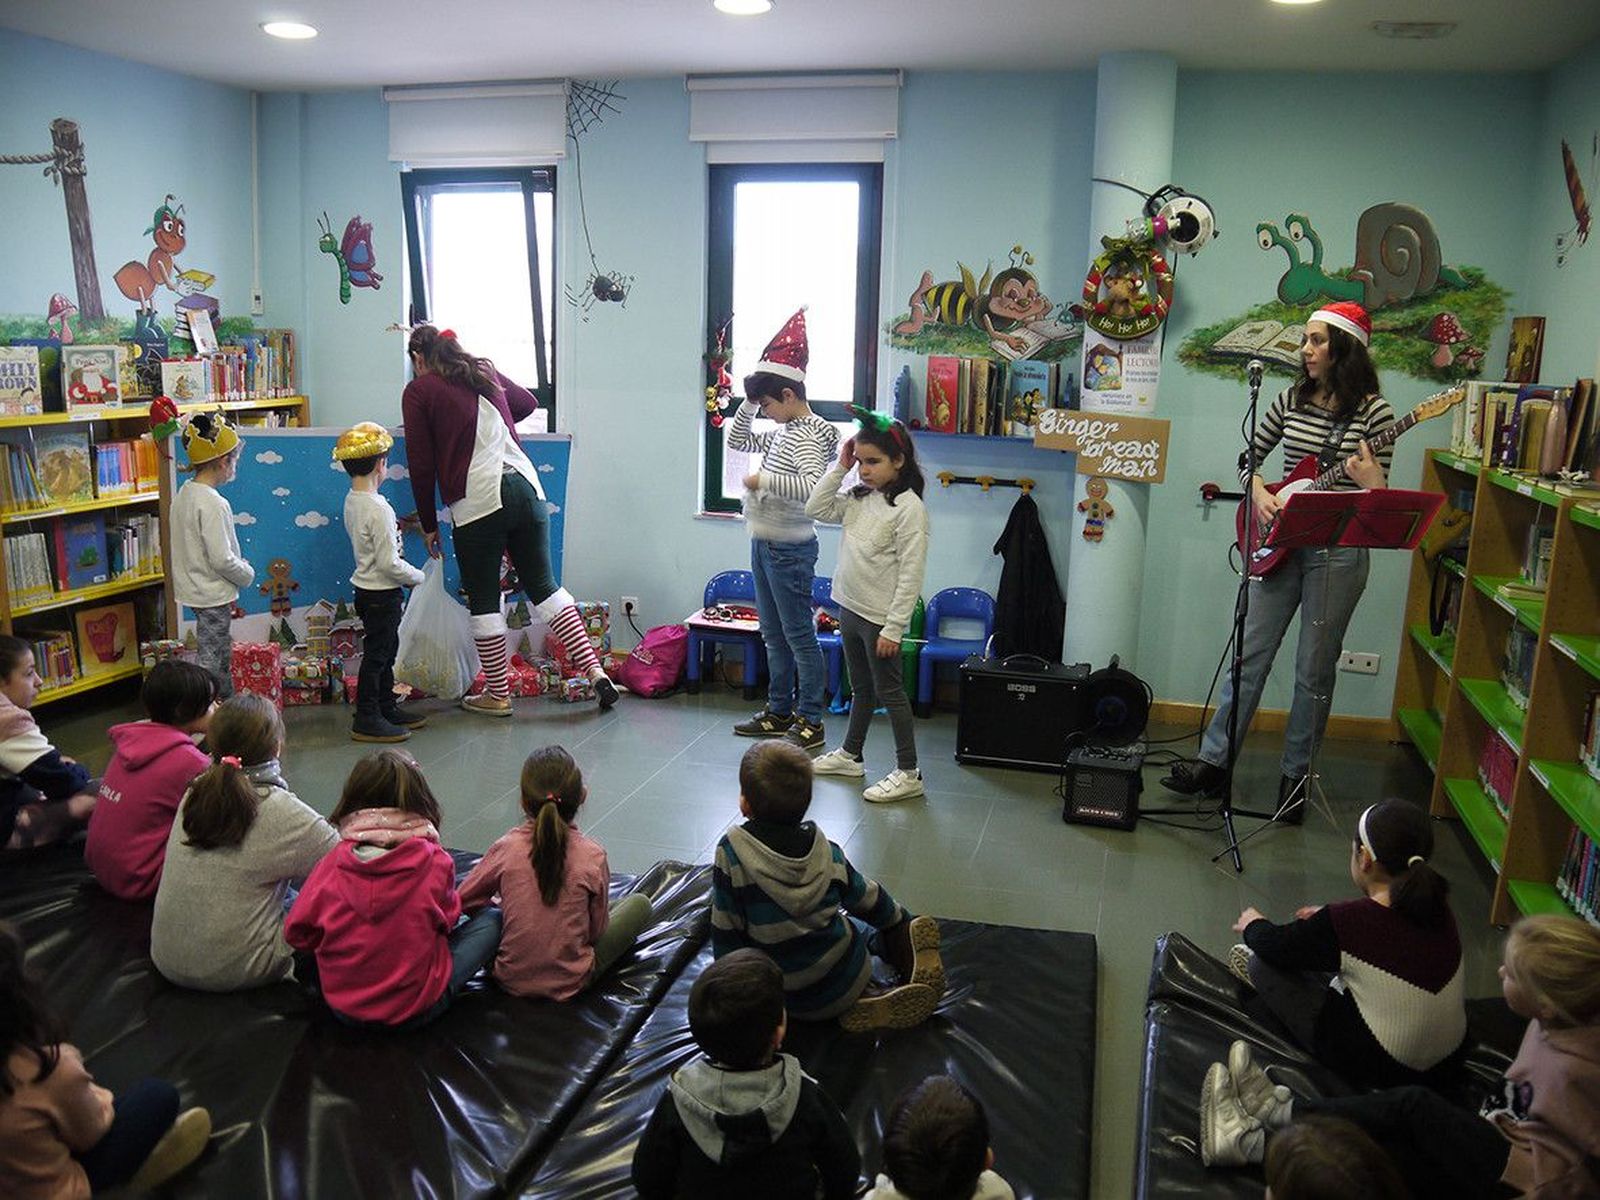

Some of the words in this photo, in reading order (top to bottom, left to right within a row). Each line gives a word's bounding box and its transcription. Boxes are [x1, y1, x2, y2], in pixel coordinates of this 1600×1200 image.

[1039, 408, 1120, 446] Ginger
[1081, 439, 1160, 460] bread
[1097, 455, 1158, 477] man
[1007, 684, 1036, 693] BOSS
